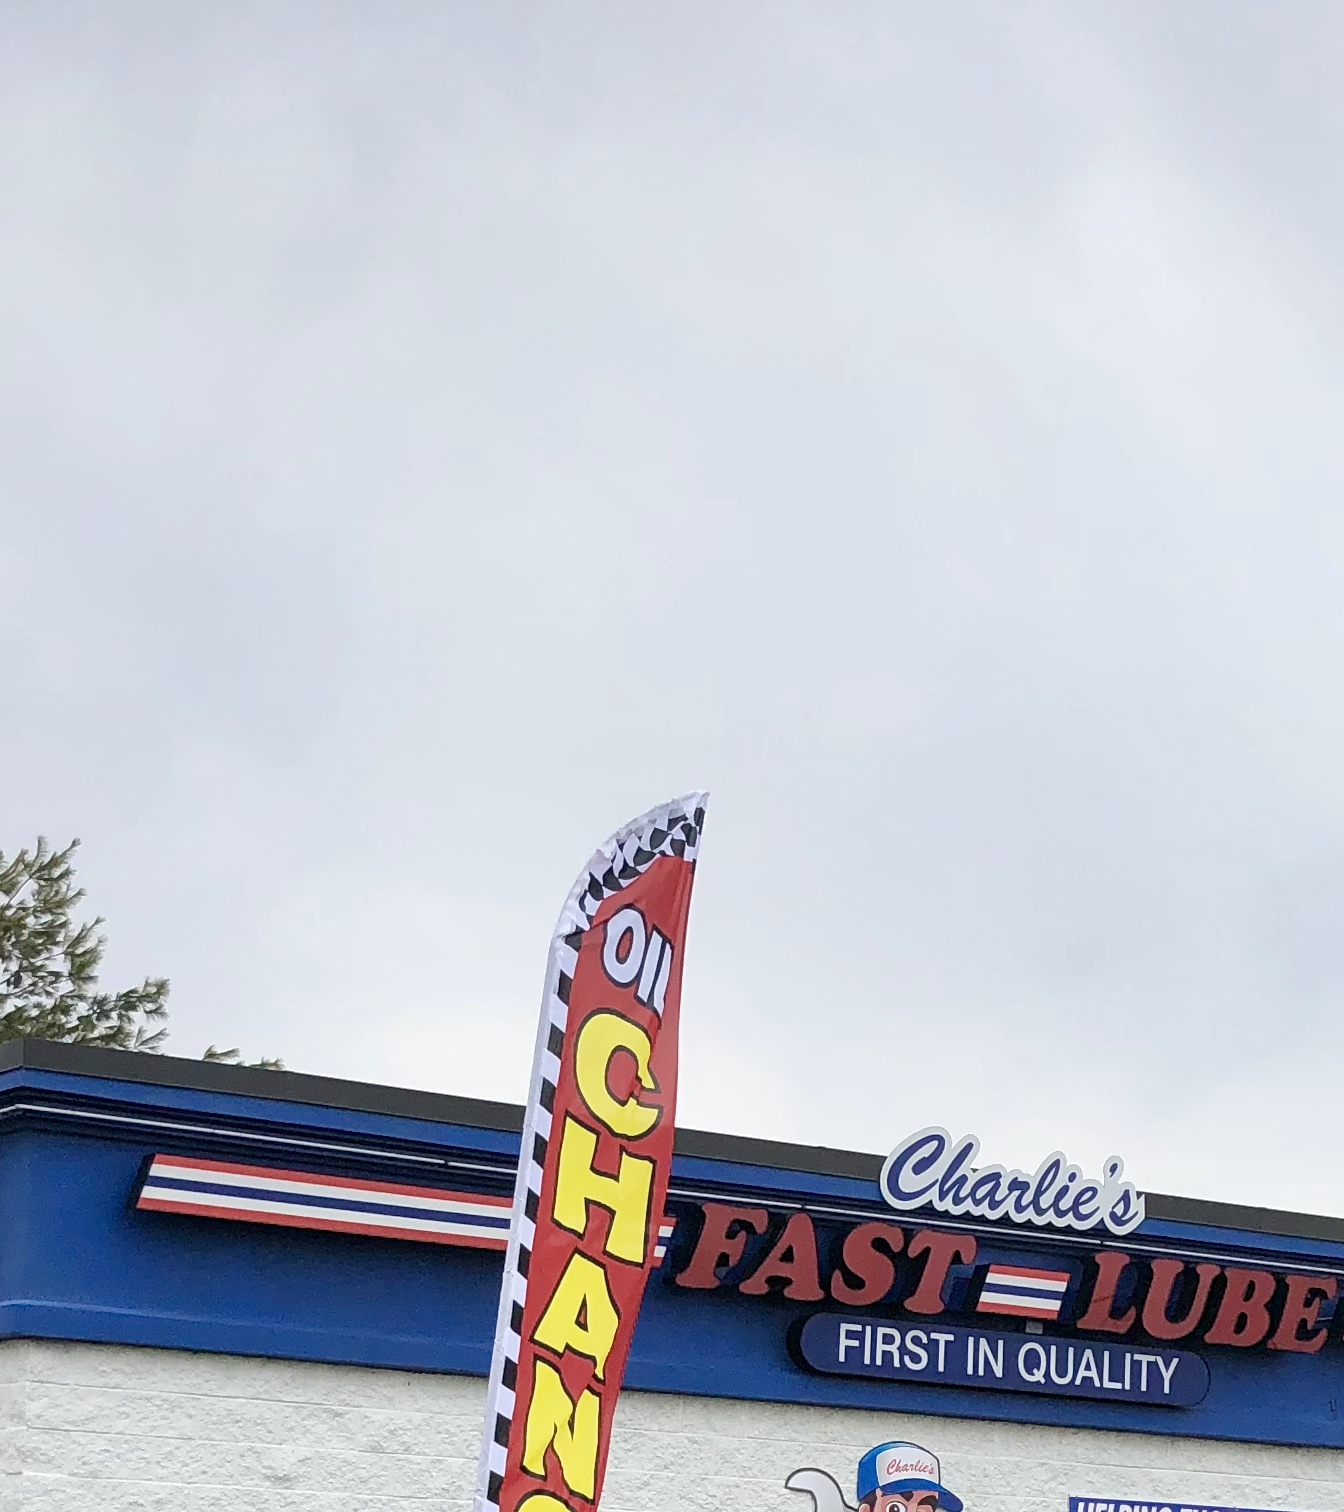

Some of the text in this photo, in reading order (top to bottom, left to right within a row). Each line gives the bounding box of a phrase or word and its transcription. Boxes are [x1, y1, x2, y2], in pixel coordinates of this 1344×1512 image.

[886, 1133, 1140, 1224] Charlie's
[674, 1201, 1340, 1353] FAST LUBE
[838, 1322, 1181, 1396] FIRST IN QUALITY
[886, 1458, 935, 1475] Charlie's
